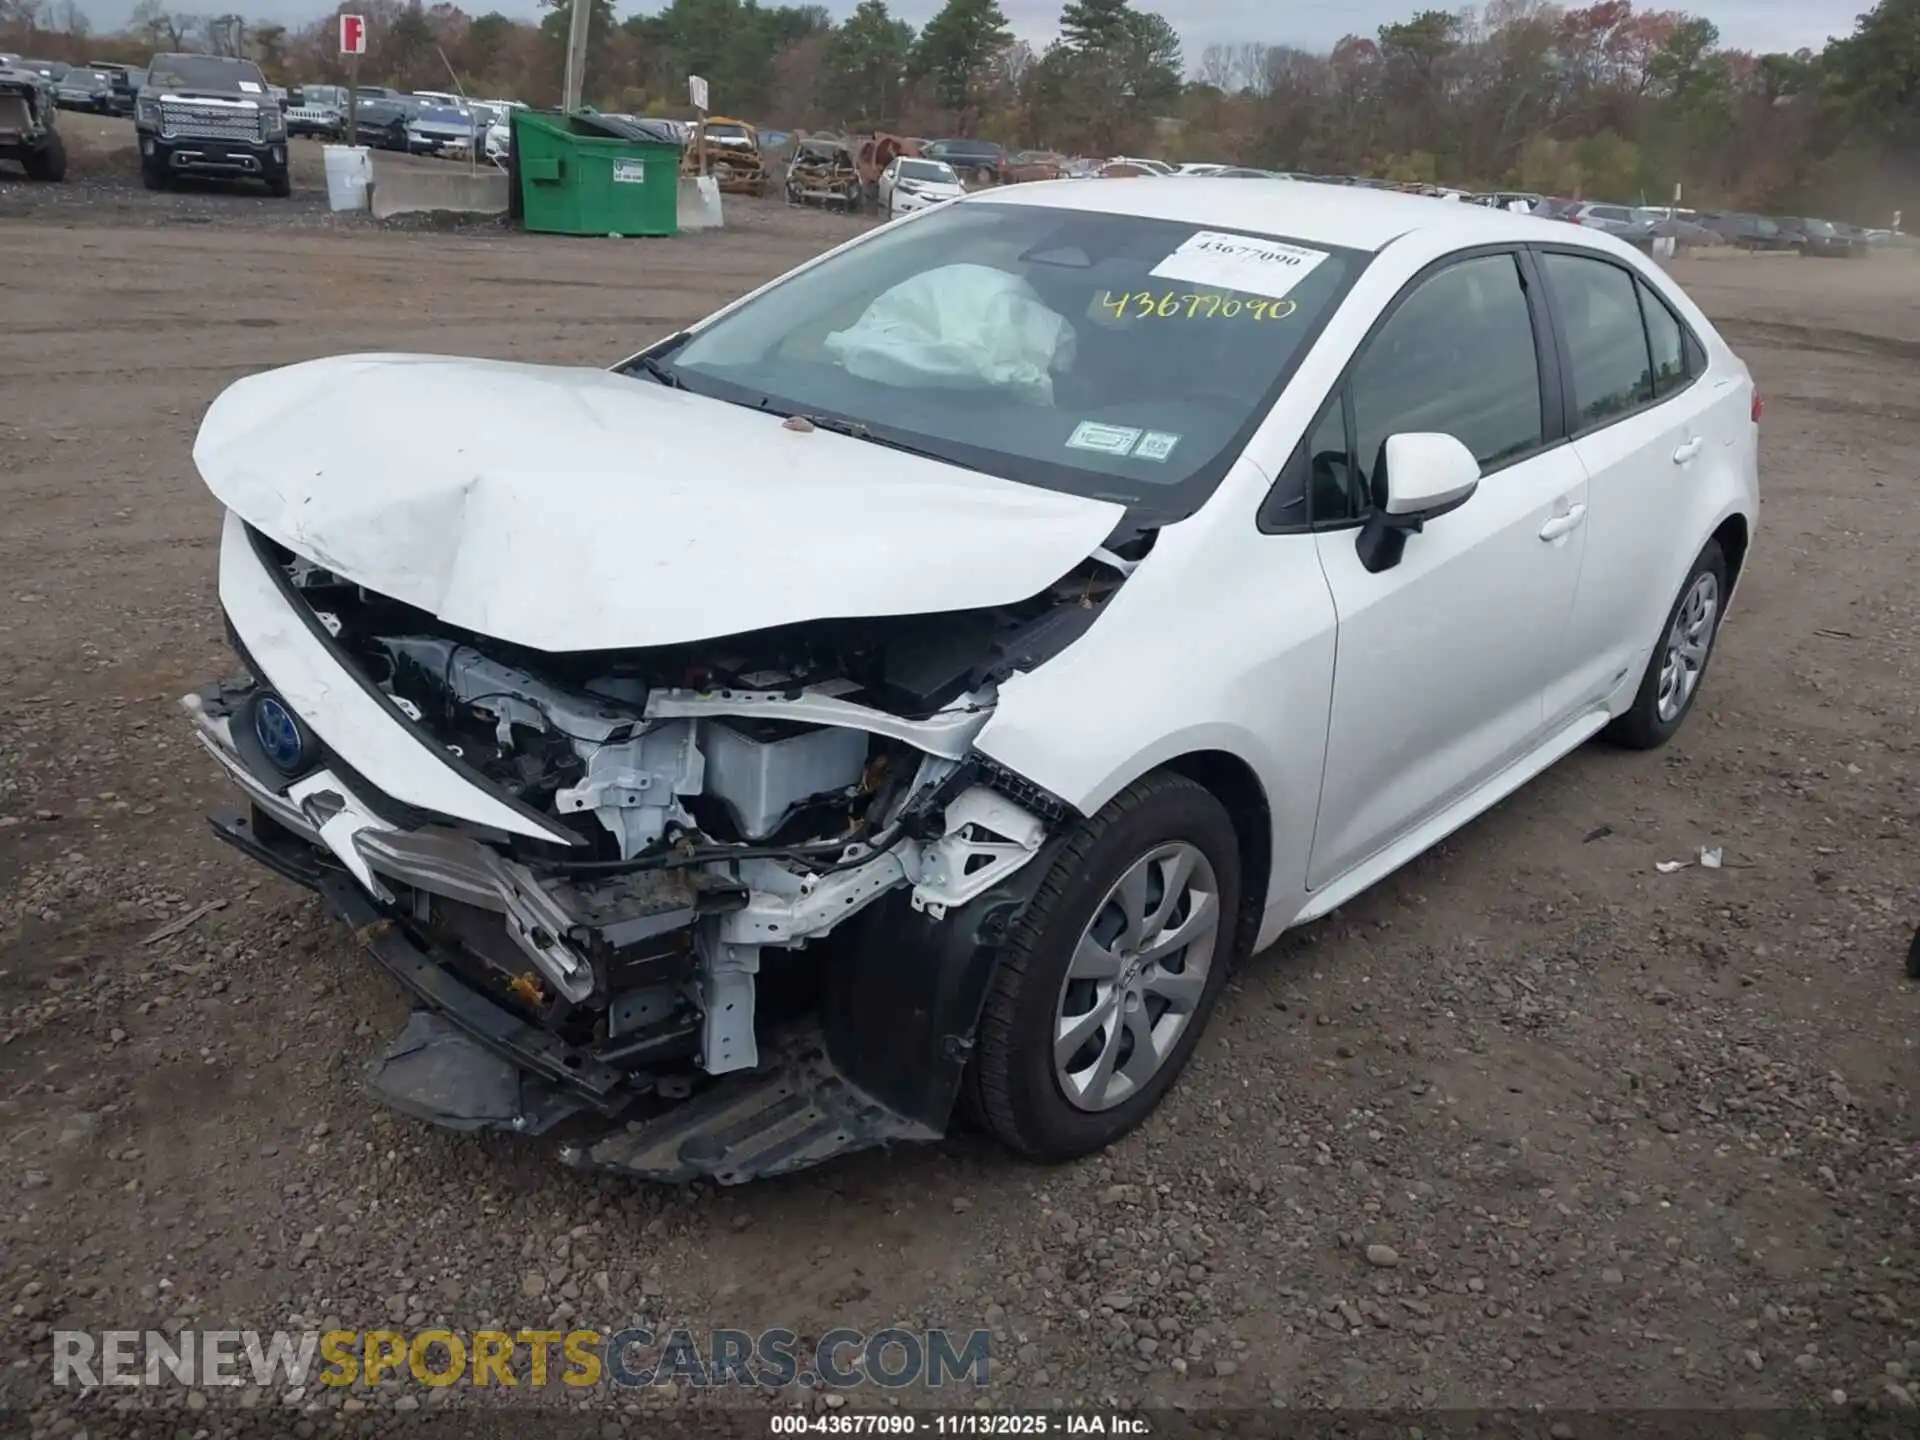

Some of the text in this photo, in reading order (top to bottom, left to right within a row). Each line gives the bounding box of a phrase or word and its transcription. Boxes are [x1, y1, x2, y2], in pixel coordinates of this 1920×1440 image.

[345, 17, 362, 51] F
[1197, 240, 1302, 267] 43677090
[1103, 290, 1297, 320] 43677090
